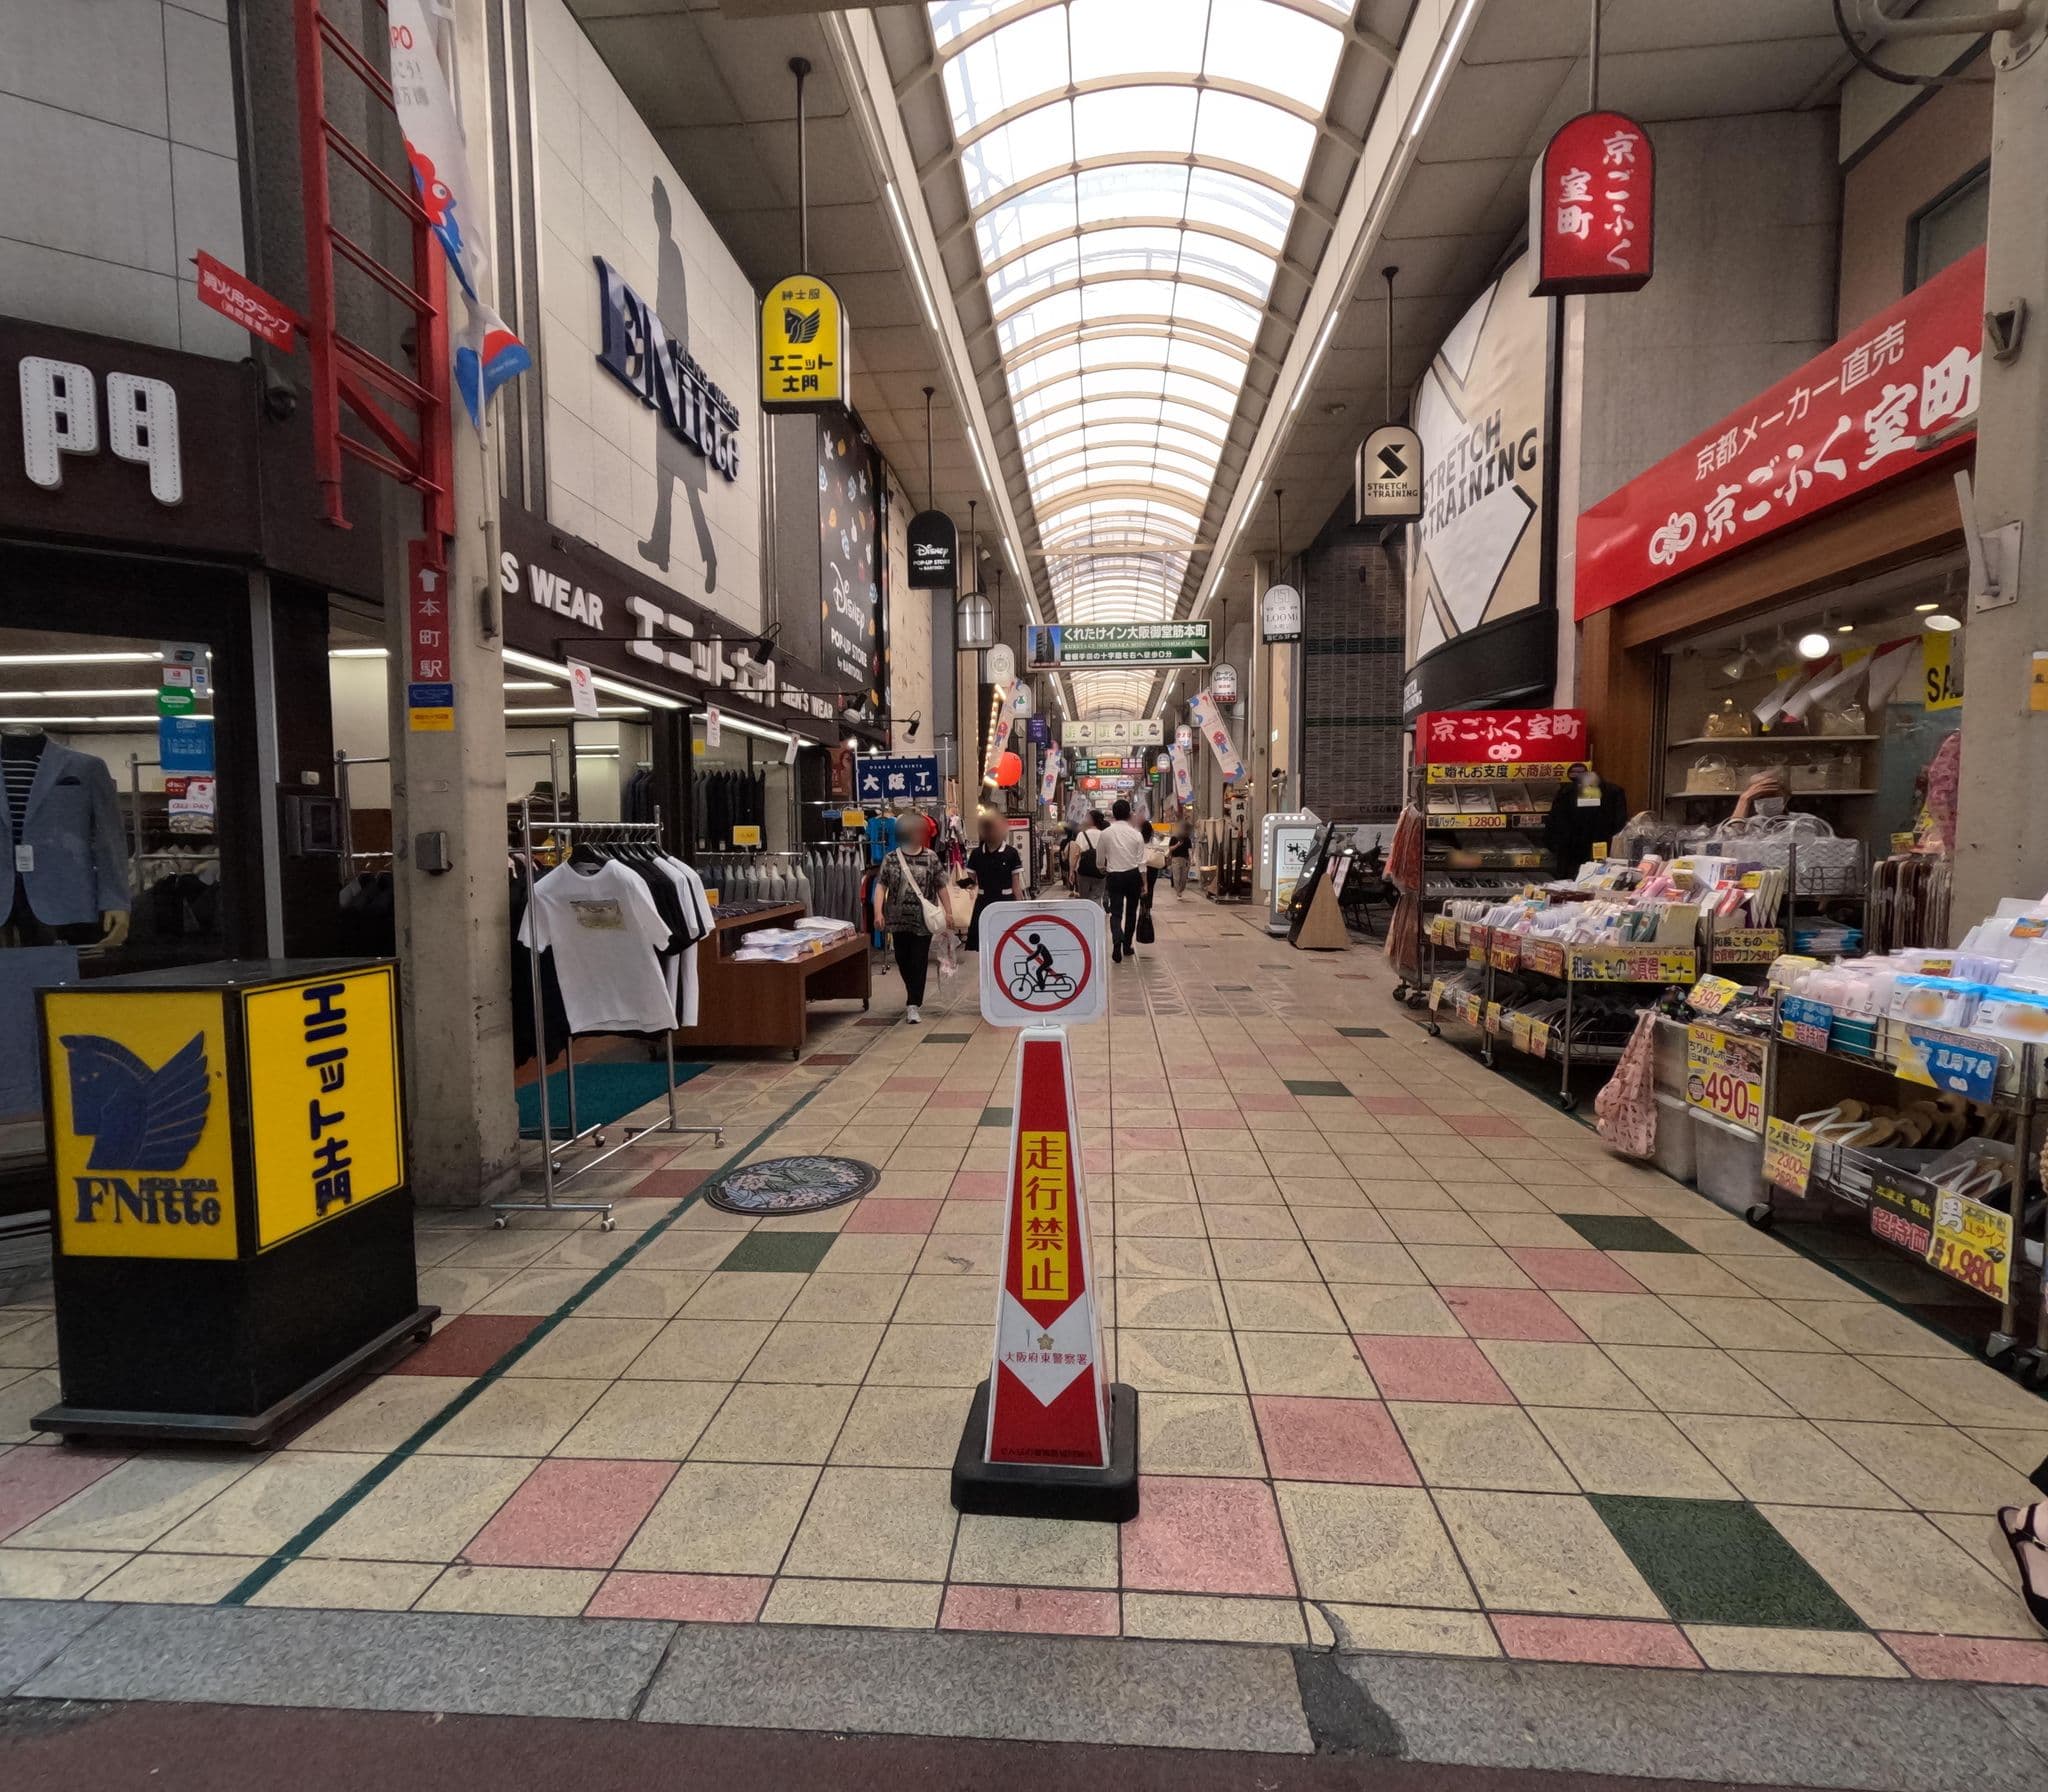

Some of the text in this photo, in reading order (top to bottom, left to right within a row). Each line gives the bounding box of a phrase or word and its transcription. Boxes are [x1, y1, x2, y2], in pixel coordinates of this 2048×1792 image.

[1557, 168, 1593, 240] 室町
[1603, 130, 1639, 271] 京ごふく
[782, 288, 820, 300] 紳士服
[769, 354, 833, 371] エニット
[1695, 319, 1906, 481] 京都メーカー直売
[19, 355, 183, 506] 門
[1424, 408, 1501, 506] STRETCH
[1702, 346, 1982, 547] 京ごふく室町
[1368, 482, 1407, 490] STRETCH
[528, 563, 605, 631] WEAR
[418, 598, 443, 678] 本町駅
[831, 627, 868, 668] POP-UP STORE
[1064, 624, 1206, 641] くれたけイン大阪御堂筋本町
[810, 693, 835, 723] WEAR
[1431, 713, 1582, 742] 京ごふく室町
[1695, 1030, 1716, 1044] SALE
[303, 983, 352, 1217] エニット土門
[1705, 1071, 1760, 1127] 490円
[1025, 1135, 1064, 1294] 走行禁止
[1872, 1206, 1931, 1254] 超特価
[1006, 1351, 1088, 1366] 大阪府東警察署
